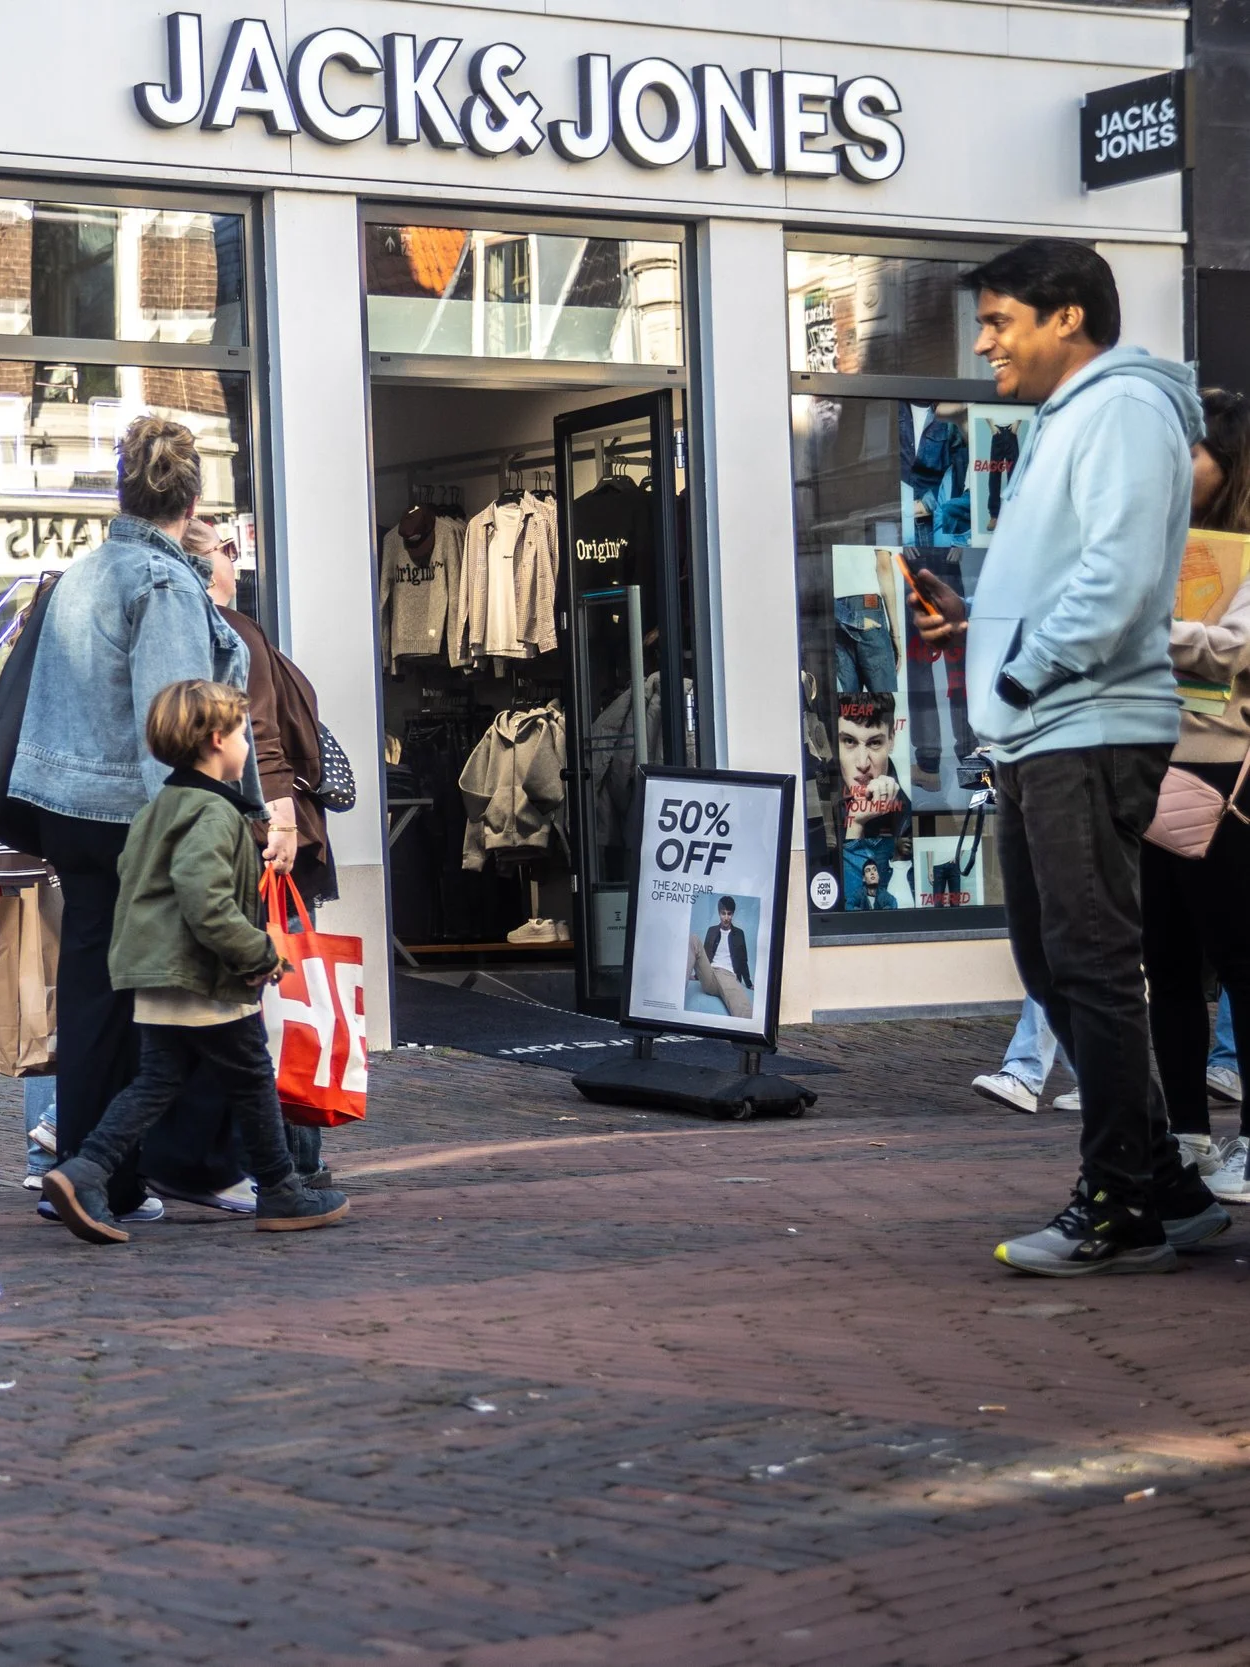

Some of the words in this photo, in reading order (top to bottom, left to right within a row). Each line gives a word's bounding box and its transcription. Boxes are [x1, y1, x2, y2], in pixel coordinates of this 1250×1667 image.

[1095, 97, 1175, 138] JACK&
[1095, 123, 1177, 163] JONES
[973, 459, 1014, 473] BAGGY
[840, 703, 874, 717] WEAR
[843, 785, 868, 798] LIKE
[844, 801, 867, 812] YOU
[870, 801, 903, 812] MEAN
[658, 798, 730, 837] 50%
[844, 816, 856, 828] IT
[655, 838, 732, 876] OFF
[653, 880, 670, 891] THE
[672, 881, 691, 893] 2ND
[693, 884, 713, 895] PAIR
[651, 891, 664, 901] OF
[920, 892, 971, 906] TAPERED
[497, 1043, 576, 1055] JACK
